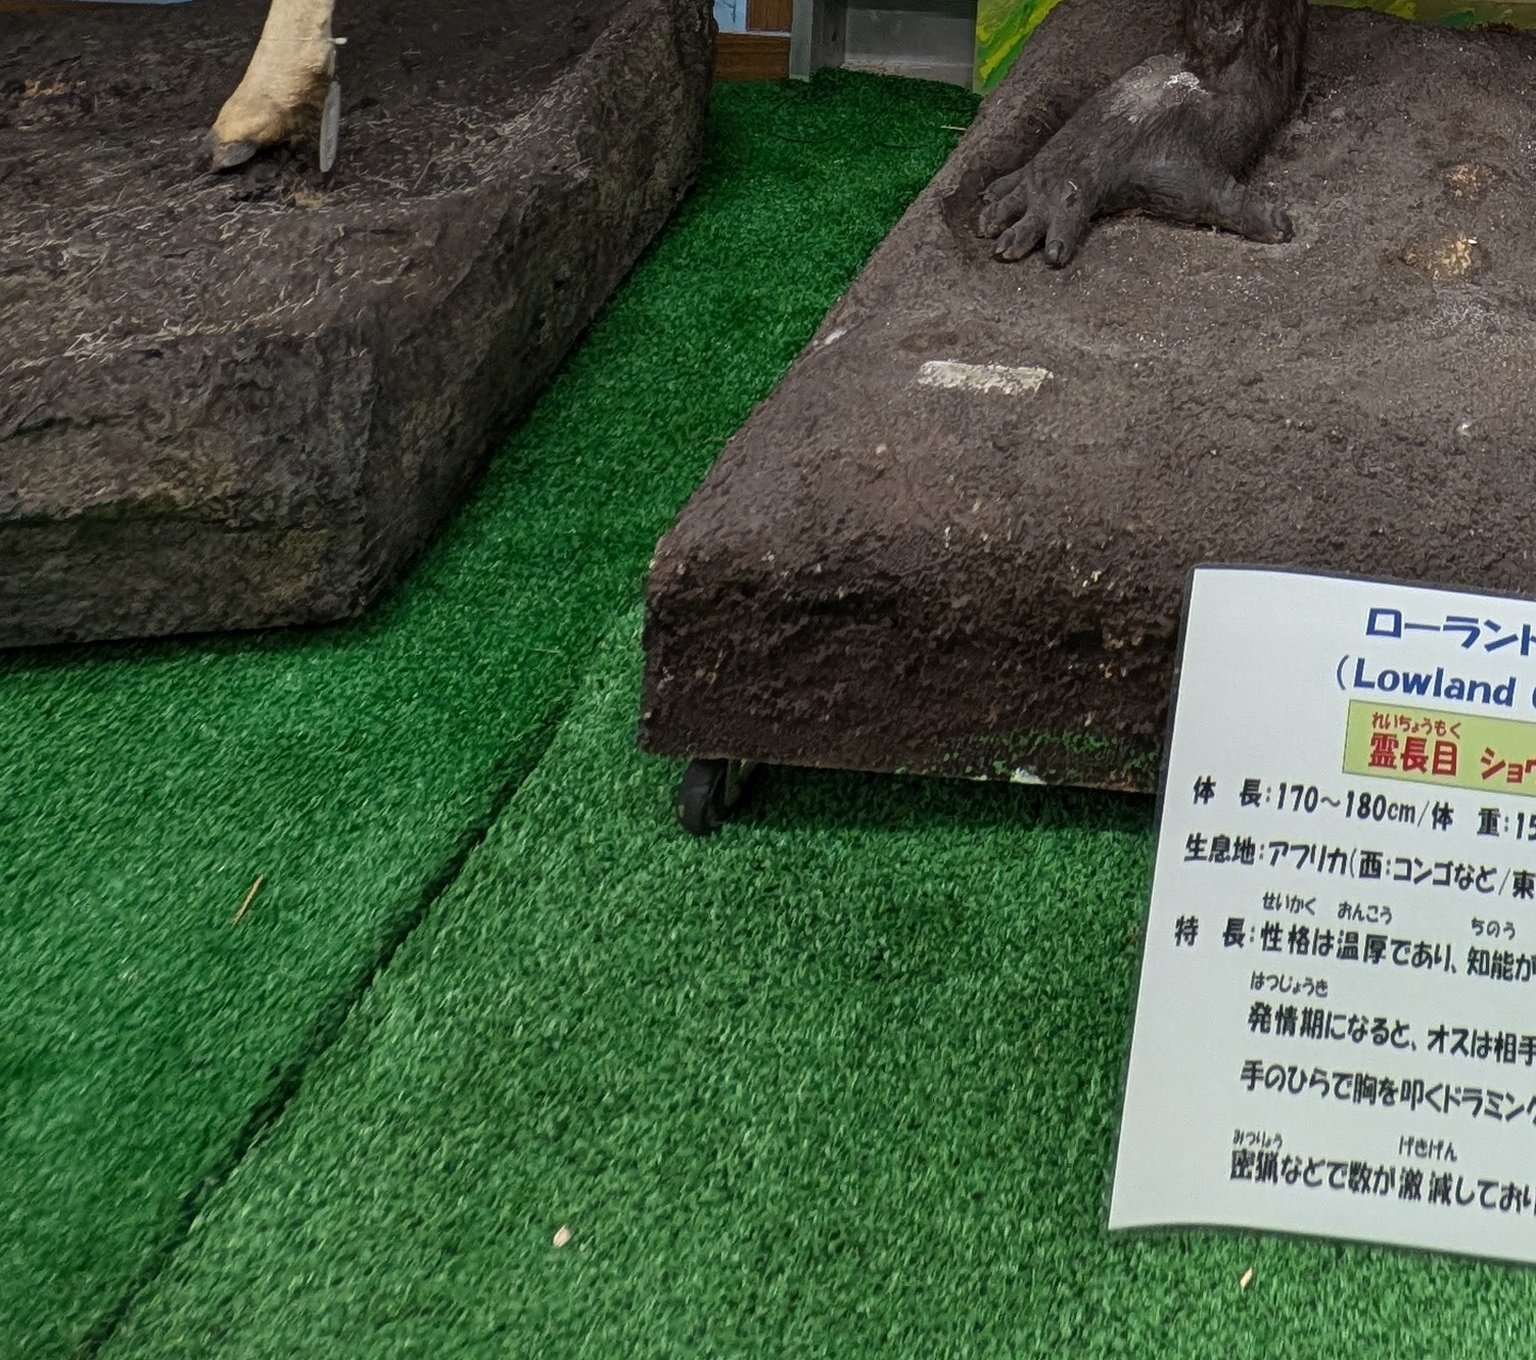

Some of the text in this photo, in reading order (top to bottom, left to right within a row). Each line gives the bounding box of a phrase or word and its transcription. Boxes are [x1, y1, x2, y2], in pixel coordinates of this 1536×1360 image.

[1336, 655, 1517, 708] (Lowland
[1368, 732, 1458, 778] 霊長目
